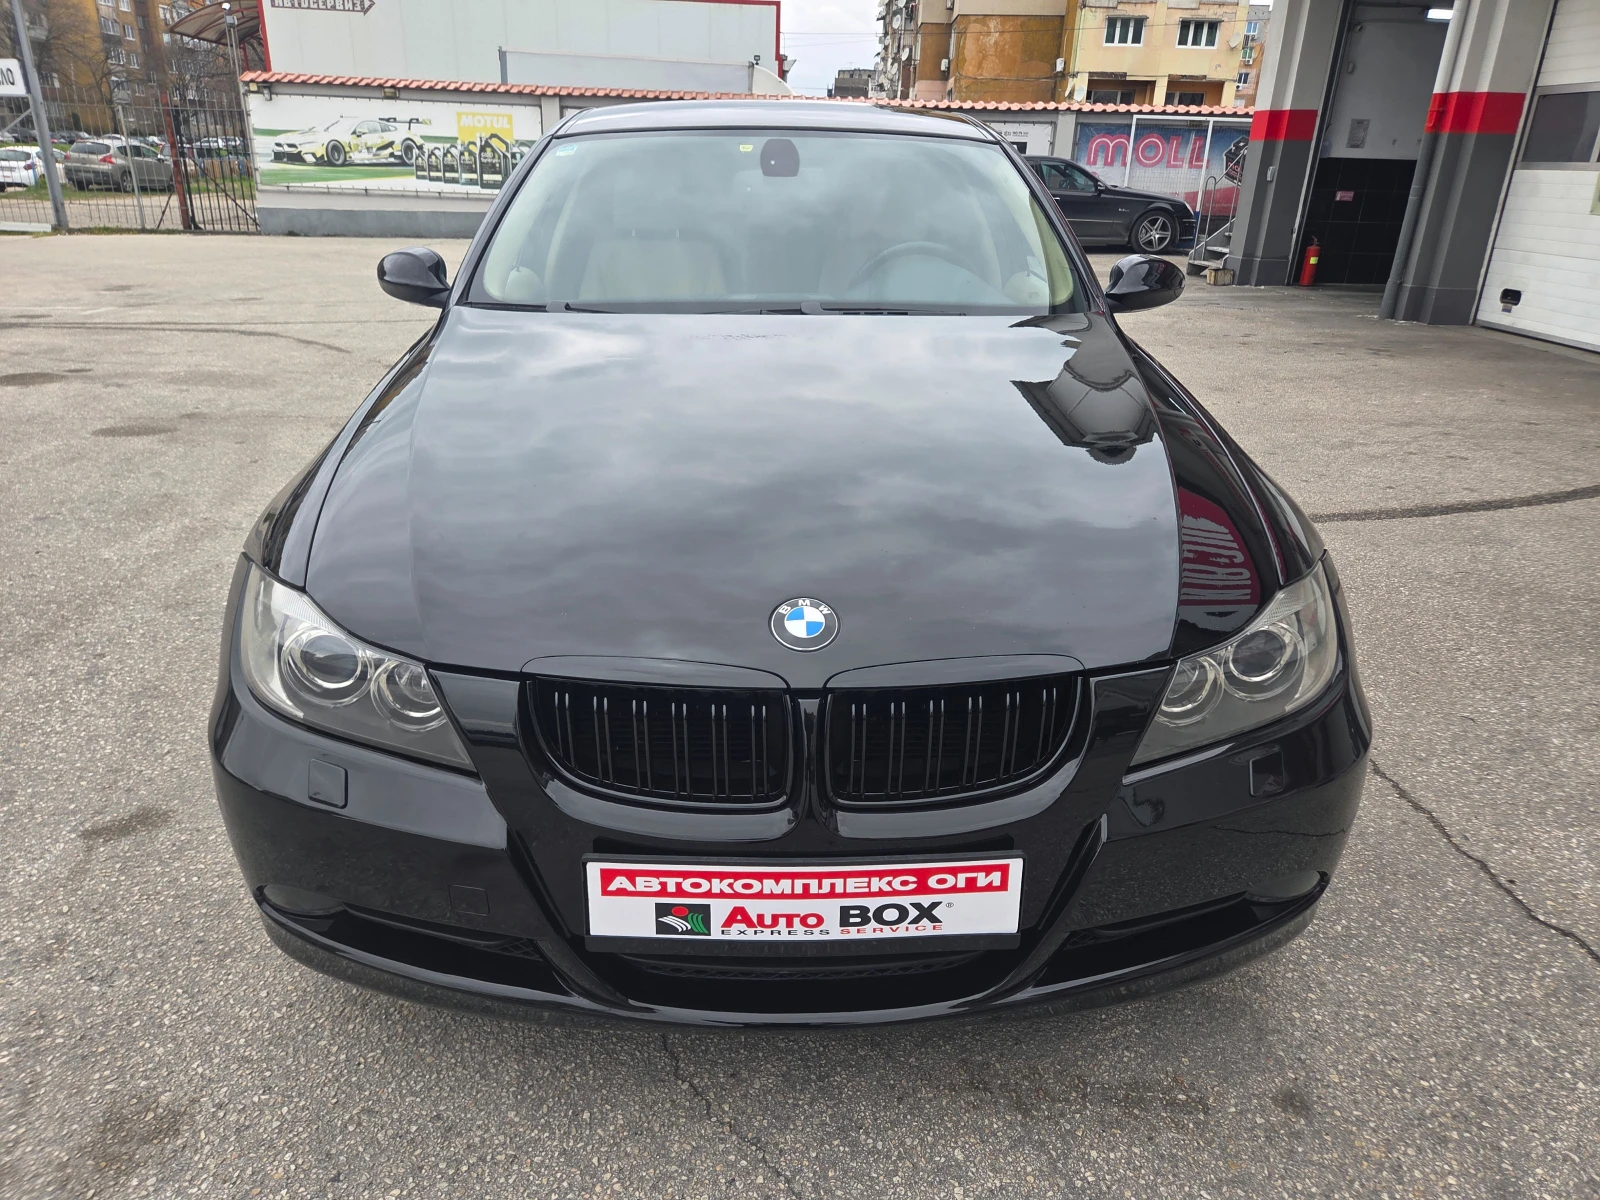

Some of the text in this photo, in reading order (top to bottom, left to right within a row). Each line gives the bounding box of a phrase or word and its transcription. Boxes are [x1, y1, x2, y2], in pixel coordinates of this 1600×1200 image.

[0, 68, 15, 86] ЛО
[460, 114, 511, 129] MOTUL
[1086, 133, 1210, 169] MOLL
[778, 599, 831, 615] BMW
[606, 871, 1002, 895] АВТОКОМПЛЕКС ОГИ
[840, 925, 943, 935] SERVICE
